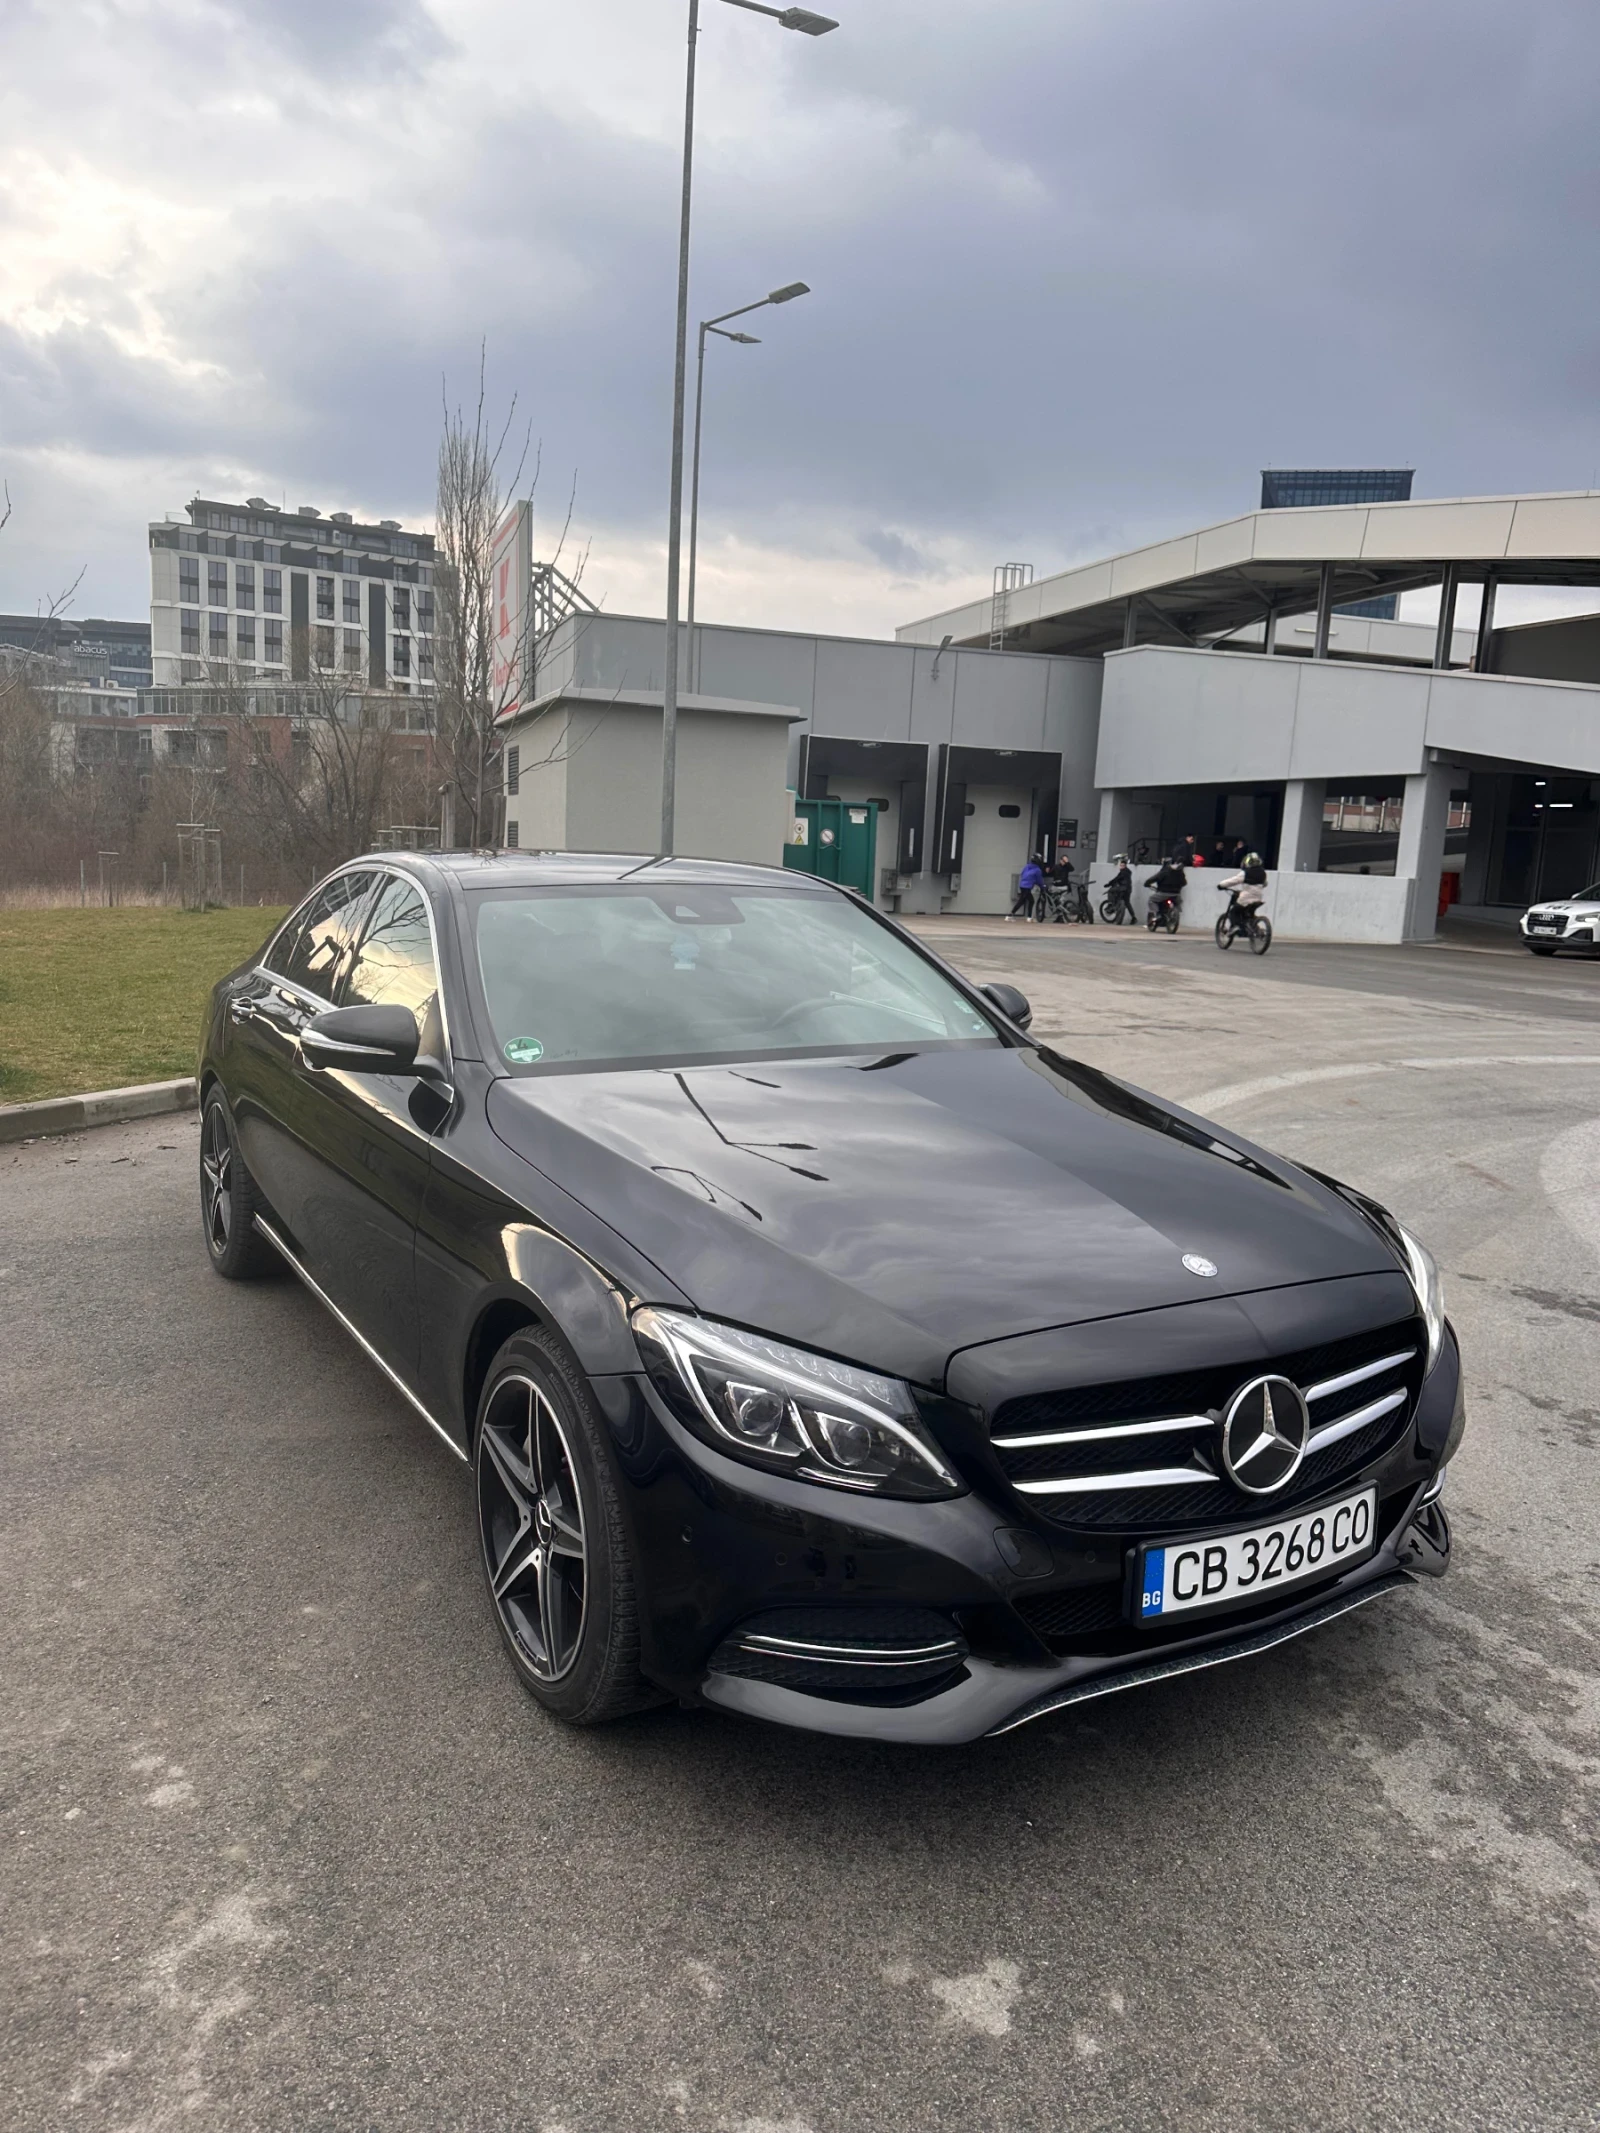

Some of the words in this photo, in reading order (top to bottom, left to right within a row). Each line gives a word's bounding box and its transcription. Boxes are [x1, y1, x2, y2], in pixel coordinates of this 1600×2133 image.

[73, 645, 107, 654] abacus
[1172, 1546, 1228, 1601] CB
[1237, 1518, 1325, 1587] 3268
[1331, 1499, 1369, 1554] CO
[1142, 1590, 1161, 1608] BG
